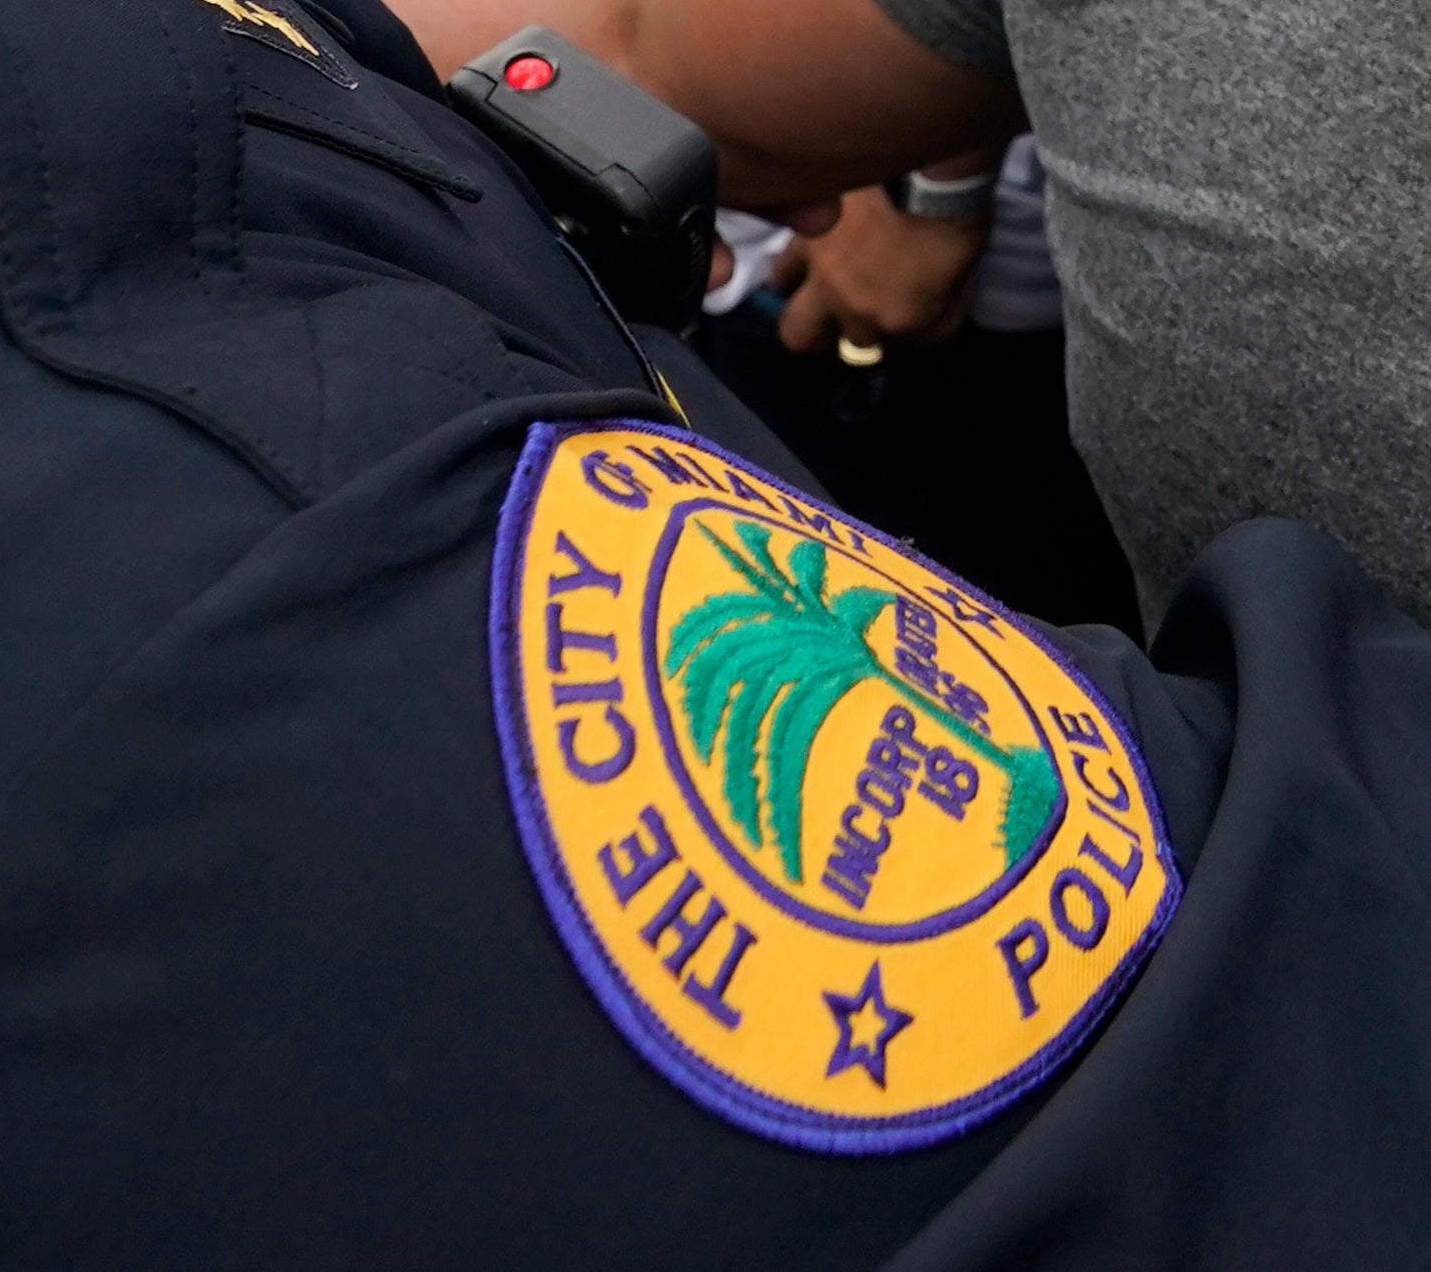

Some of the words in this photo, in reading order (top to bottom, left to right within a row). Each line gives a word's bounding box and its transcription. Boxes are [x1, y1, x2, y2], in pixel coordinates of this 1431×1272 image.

[625, 445, 873, 558] MIAMI
[543, 530, 637, 786] CITY
[820, 705, 932, 913] INCORP
[917, 745, 982, 823] 18
[992, 703, 1145, 1020] POLICE
[597, 802, 759, 1033] THE
